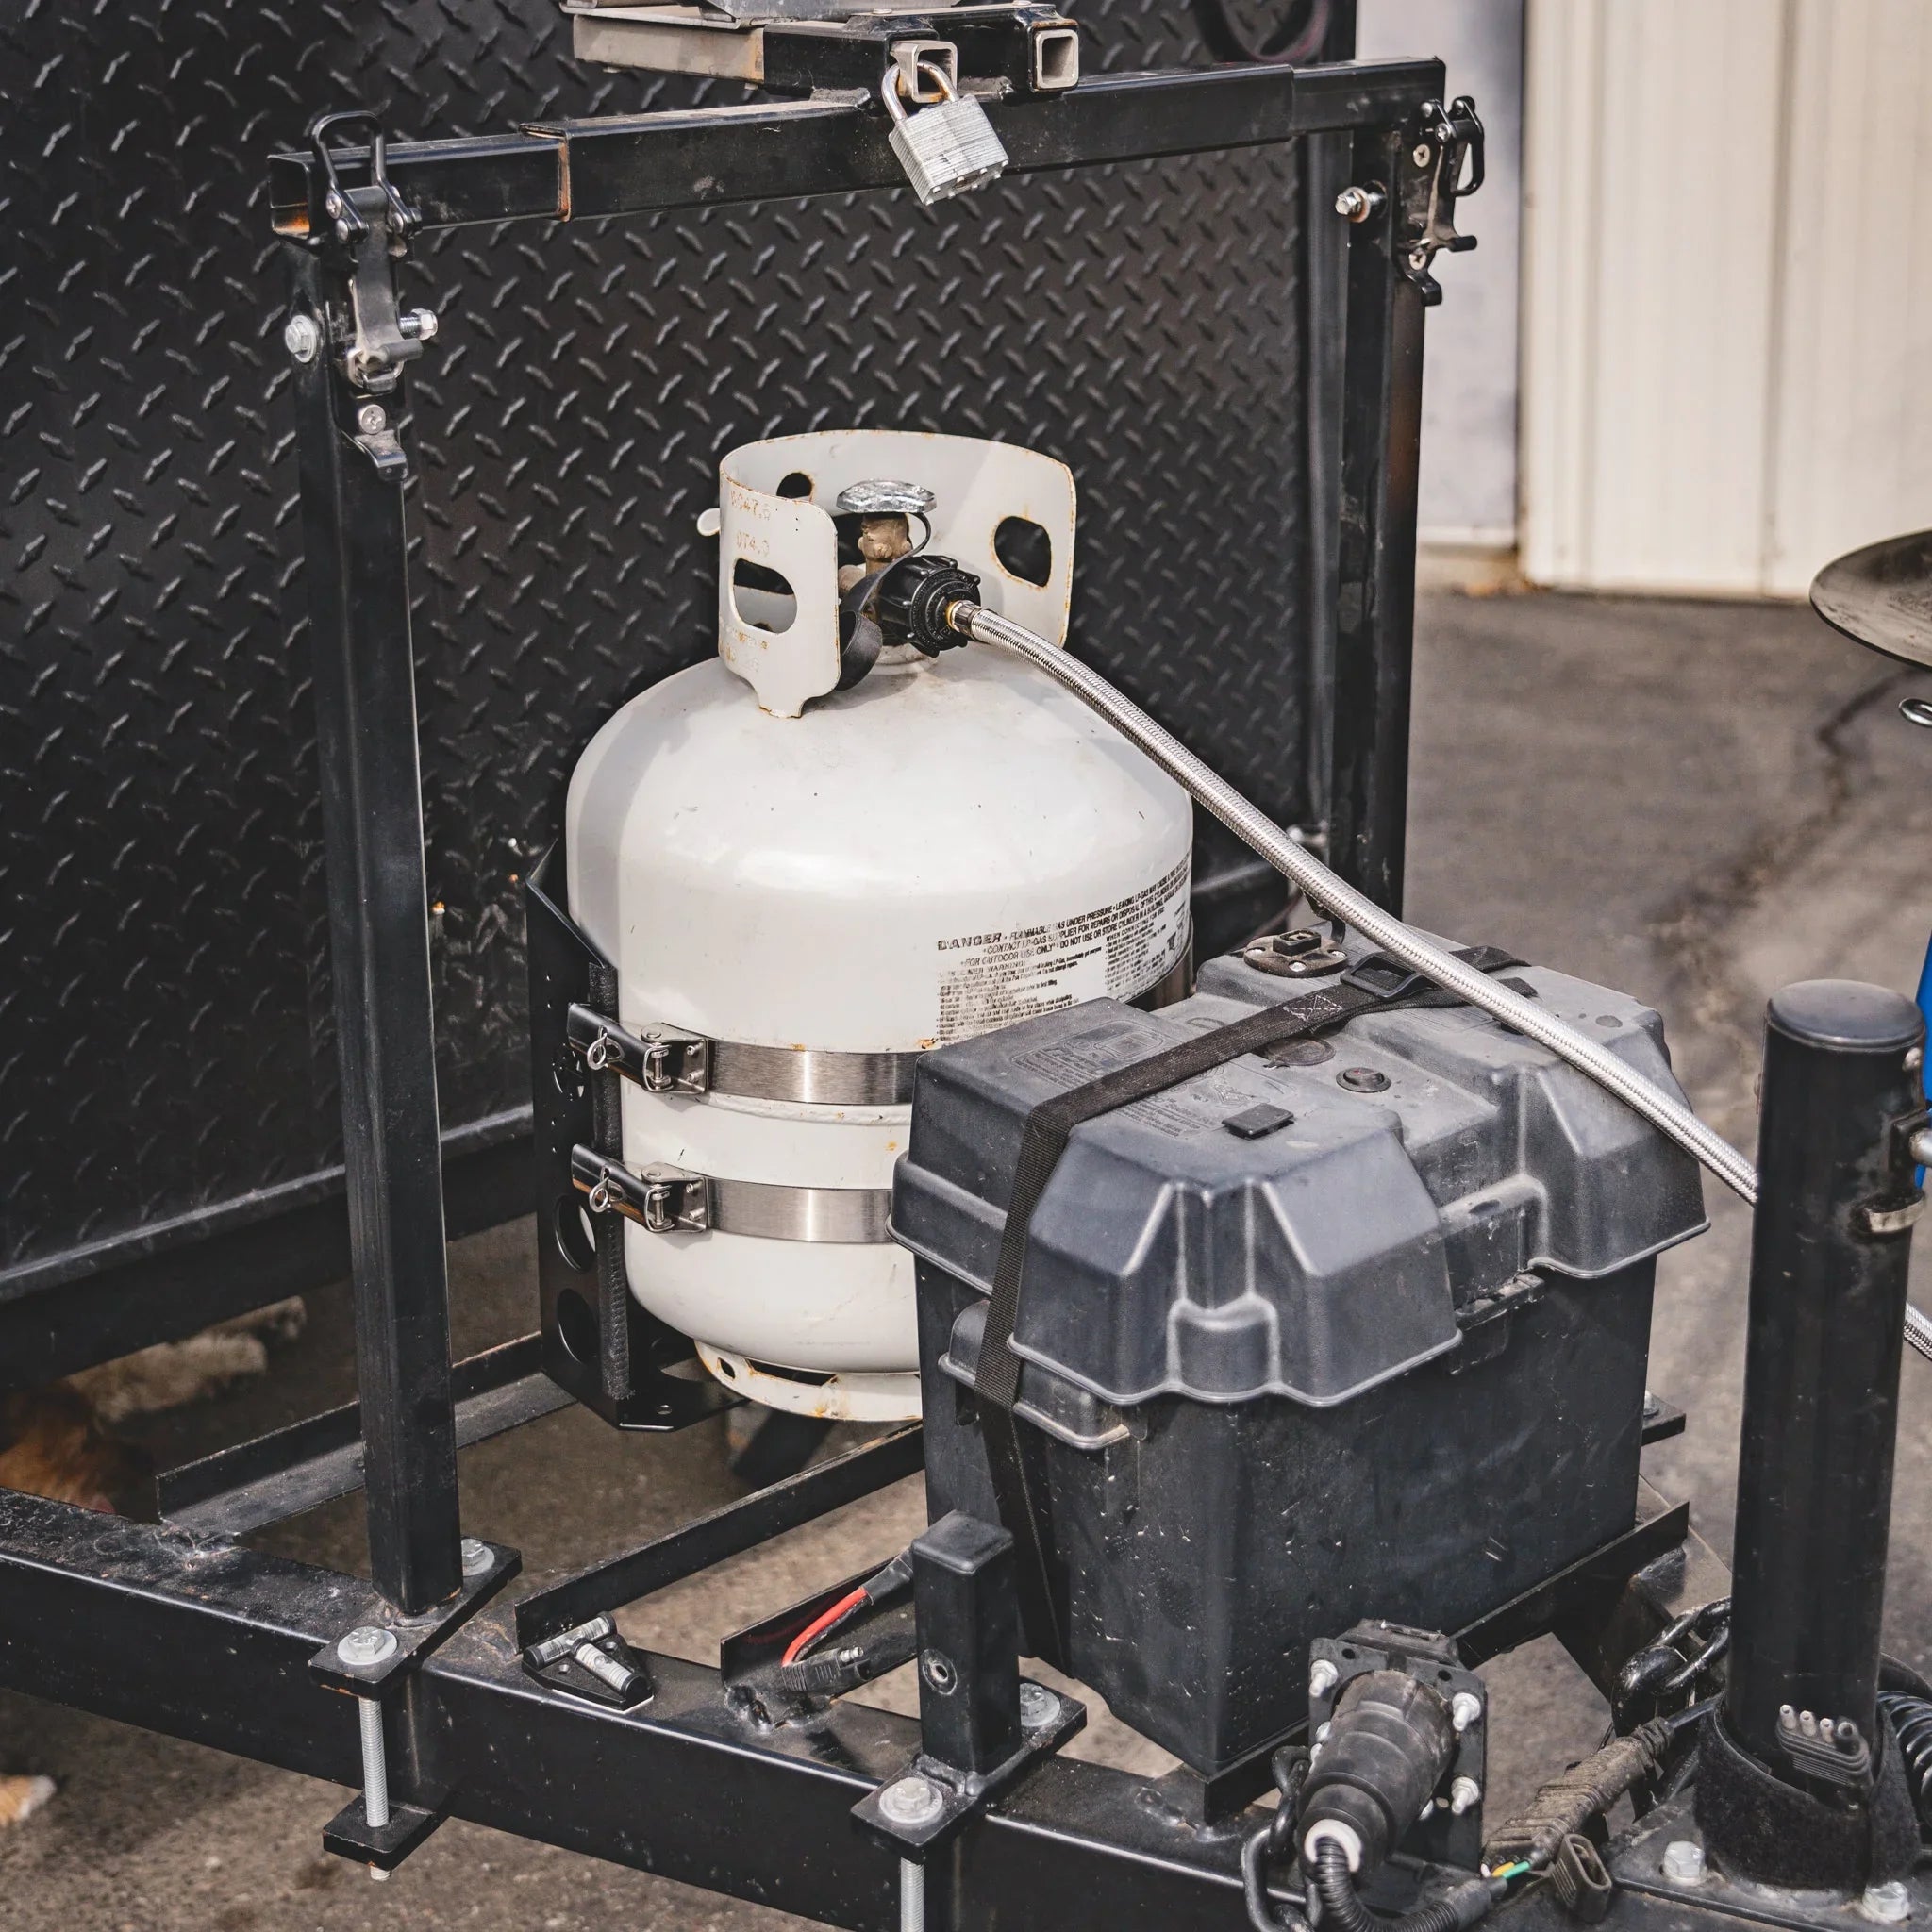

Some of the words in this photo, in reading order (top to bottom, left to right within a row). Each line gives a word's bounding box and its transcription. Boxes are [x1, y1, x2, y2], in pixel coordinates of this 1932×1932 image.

[938, 932, 1002, 950] DANGER
[1066, 914, 1085, 927] UNDER
[1086, 905, 1112, 922] PRESSURE
[1115, 895, 1134, 911] LEAKING
[982, 951, 1018, 965] OUTDOOR
[1059, 938, 1068, 949] DO
[1070, 935, 1081, 947] NOT
[1082, 931, 1092, 942] USE
[1093, 928, 1101, 940] OR
[1102, 922, 1117, 937] STORE
[988, 941, 1019, 955] CONTACT
[1047, 926, 1076, 941] SUPLIER
[1077, 924, 1089, 934] FOR
[1091, 915, 1110, 929] REPAIRS
[1111, 911, 1118, 923] OR
